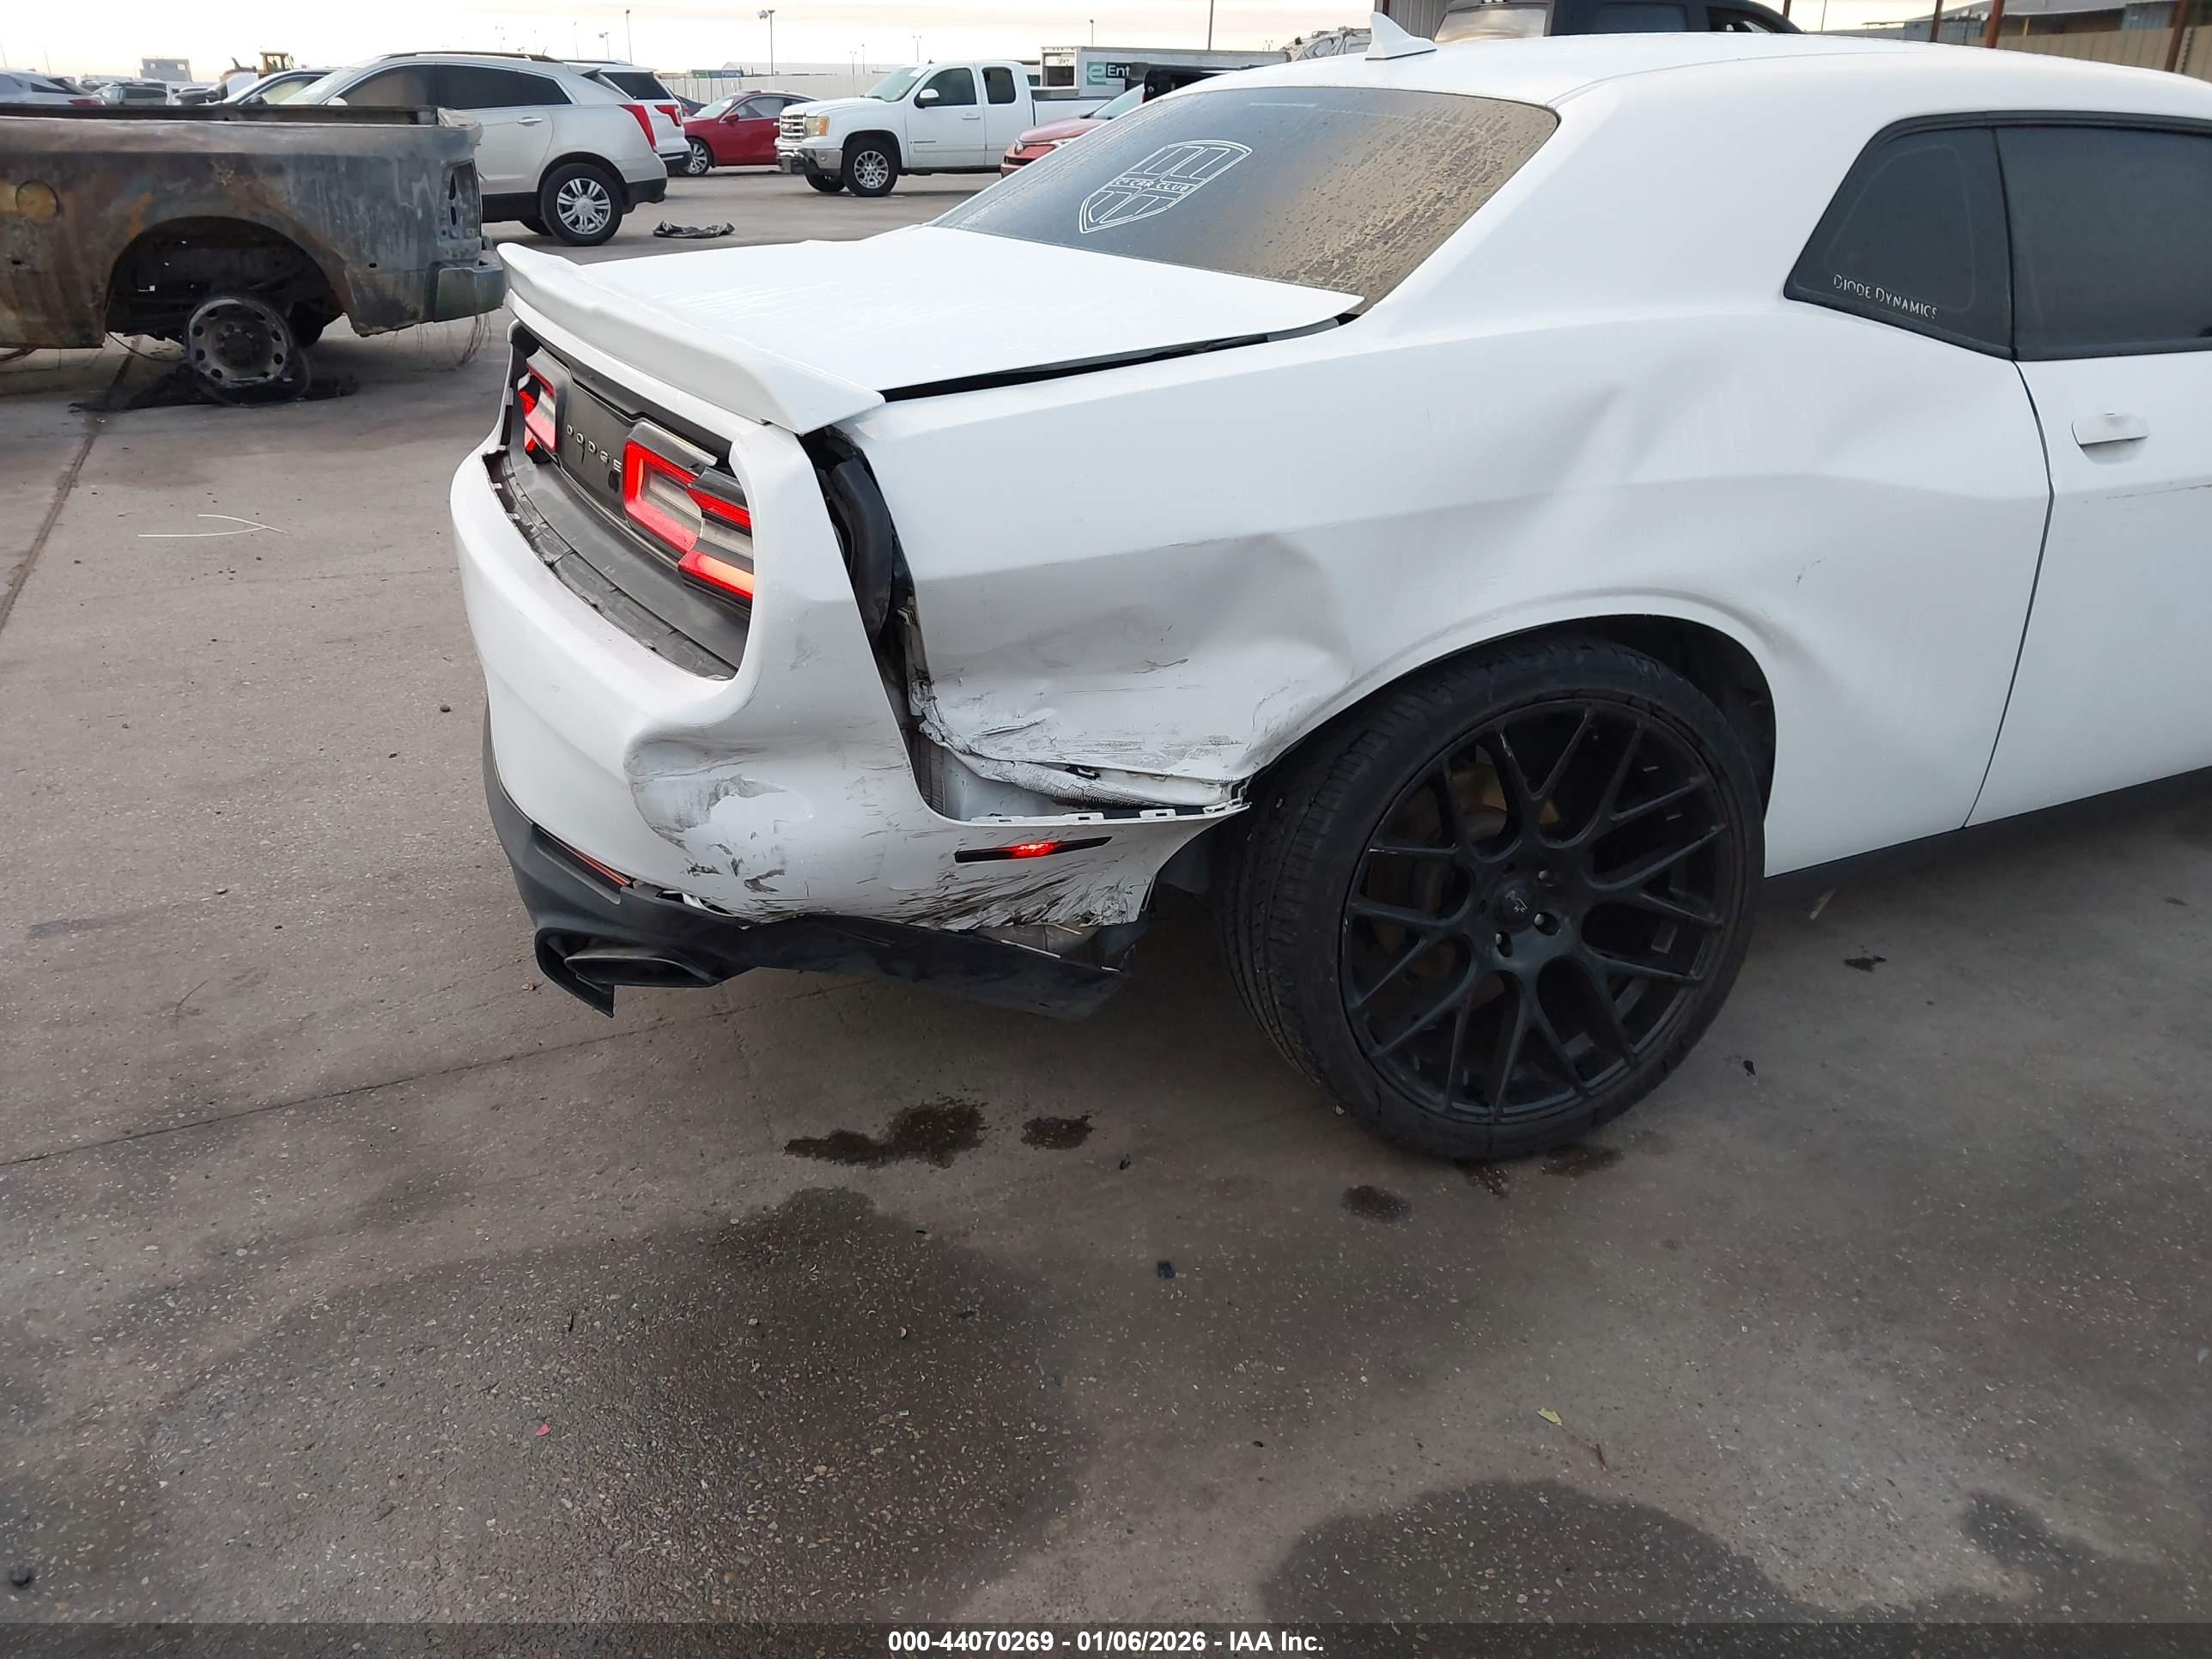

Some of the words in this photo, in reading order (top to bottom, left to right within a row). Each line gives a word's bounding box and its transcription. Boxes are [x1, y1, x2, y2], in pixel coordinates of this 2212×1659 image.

[1129, 179, 1155, 188] CAR
[1156, 182, 1189, 192] CLUB
[1875, 287, 1938, 319] DYNAMICS
[567, 423, 623, 474] DODGE
